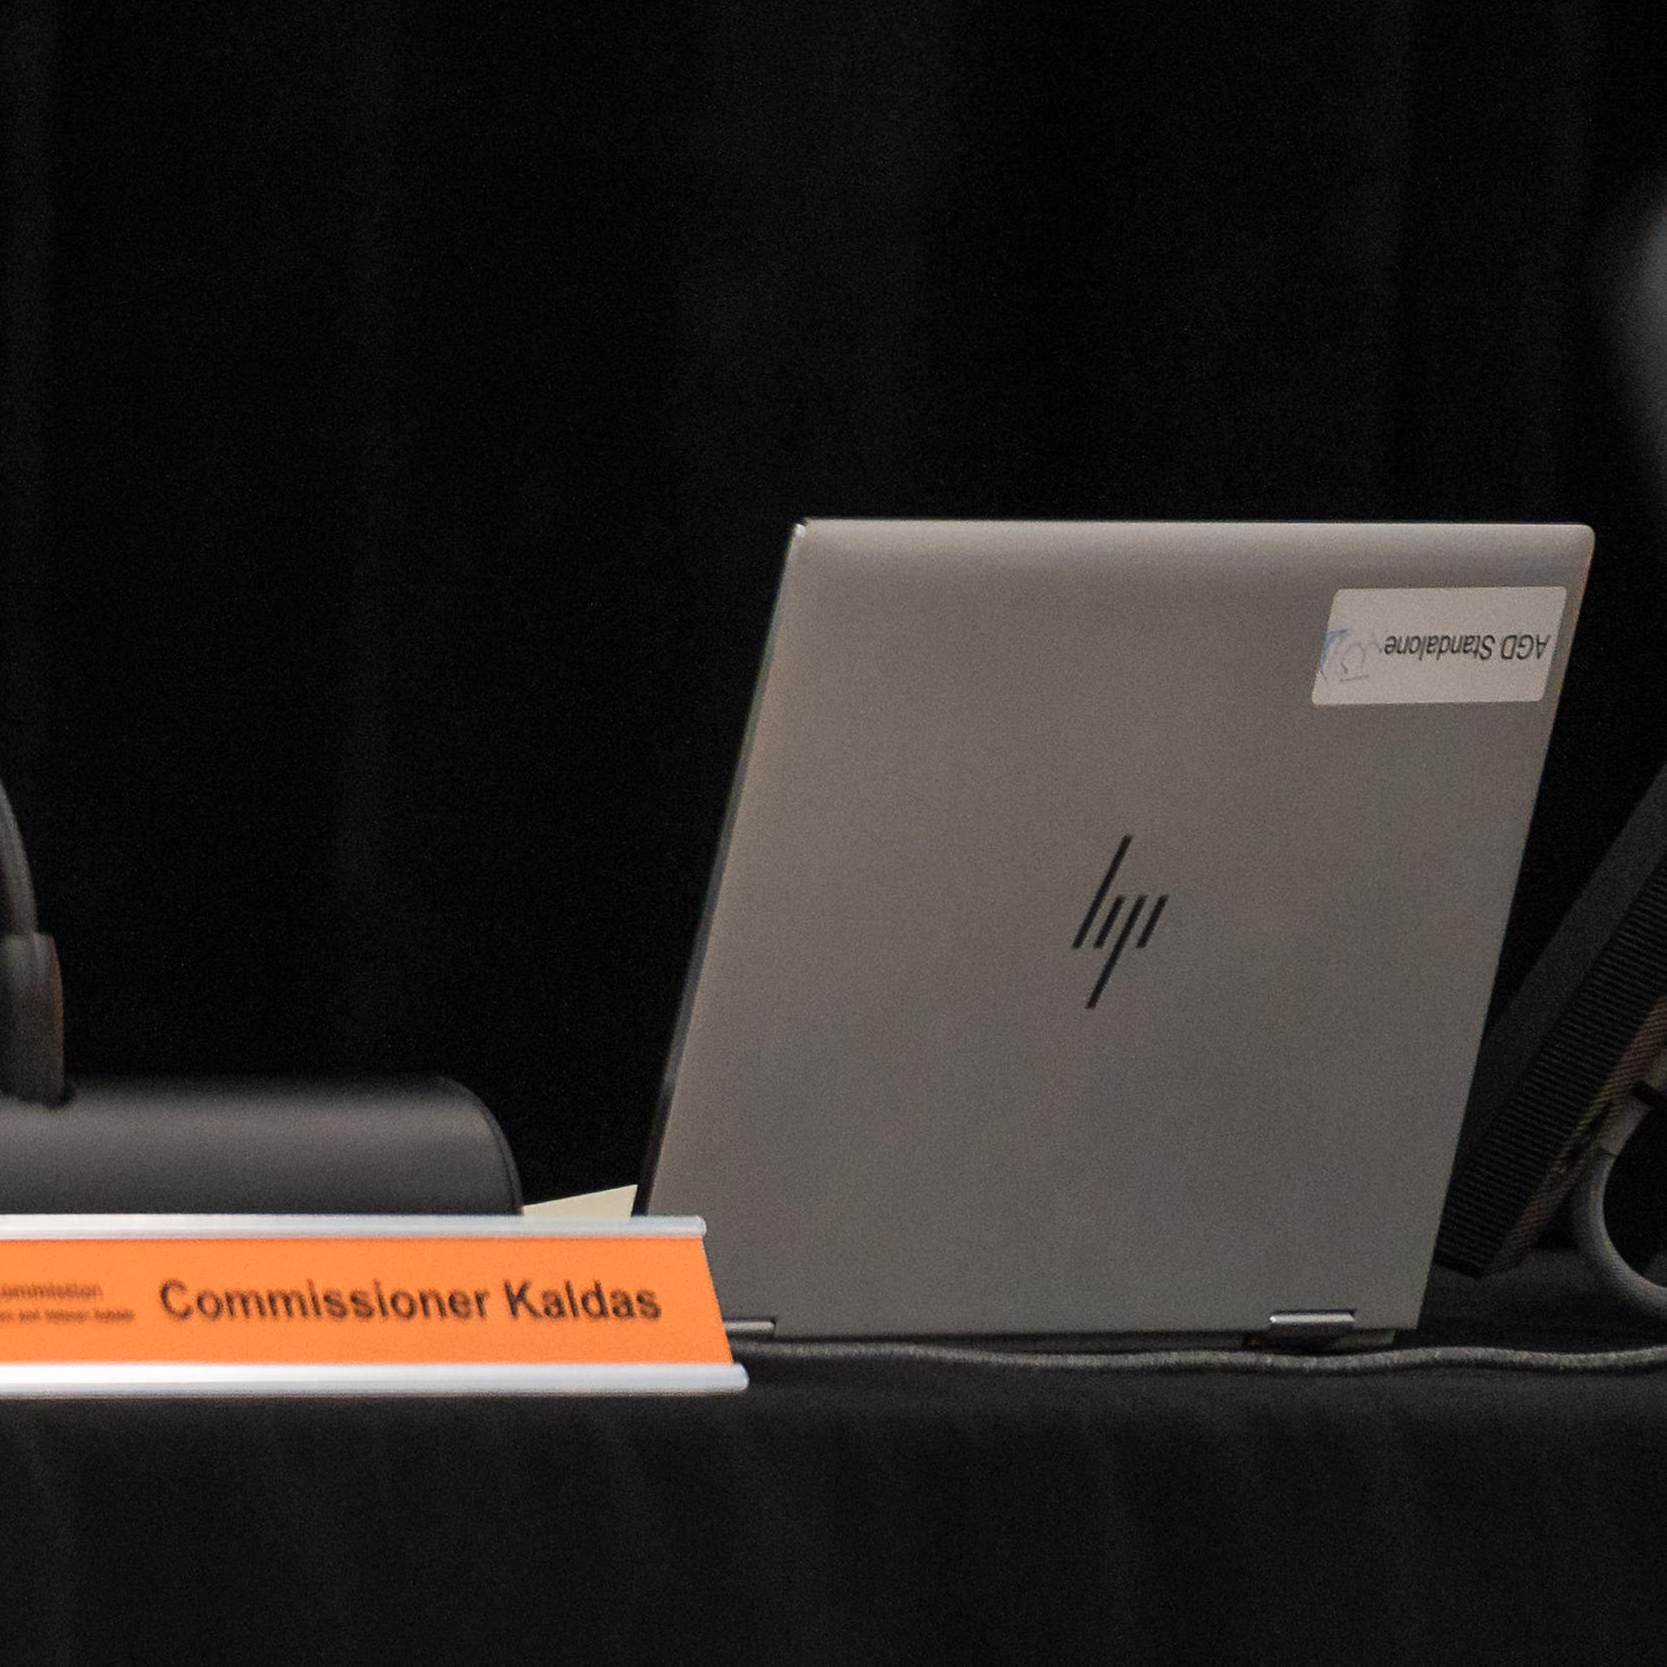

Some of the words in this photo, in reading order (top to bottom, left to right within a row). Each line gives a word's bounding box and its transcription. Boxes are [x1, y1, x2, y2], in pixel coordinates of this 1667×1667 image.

[1384, 633, 1495, 661] Standalone
[1500, 633, 1552, 660] AGD
[158, 1278, 490, 1322] Commissioner
[503, 1278, 663, 1321] Kaldas
